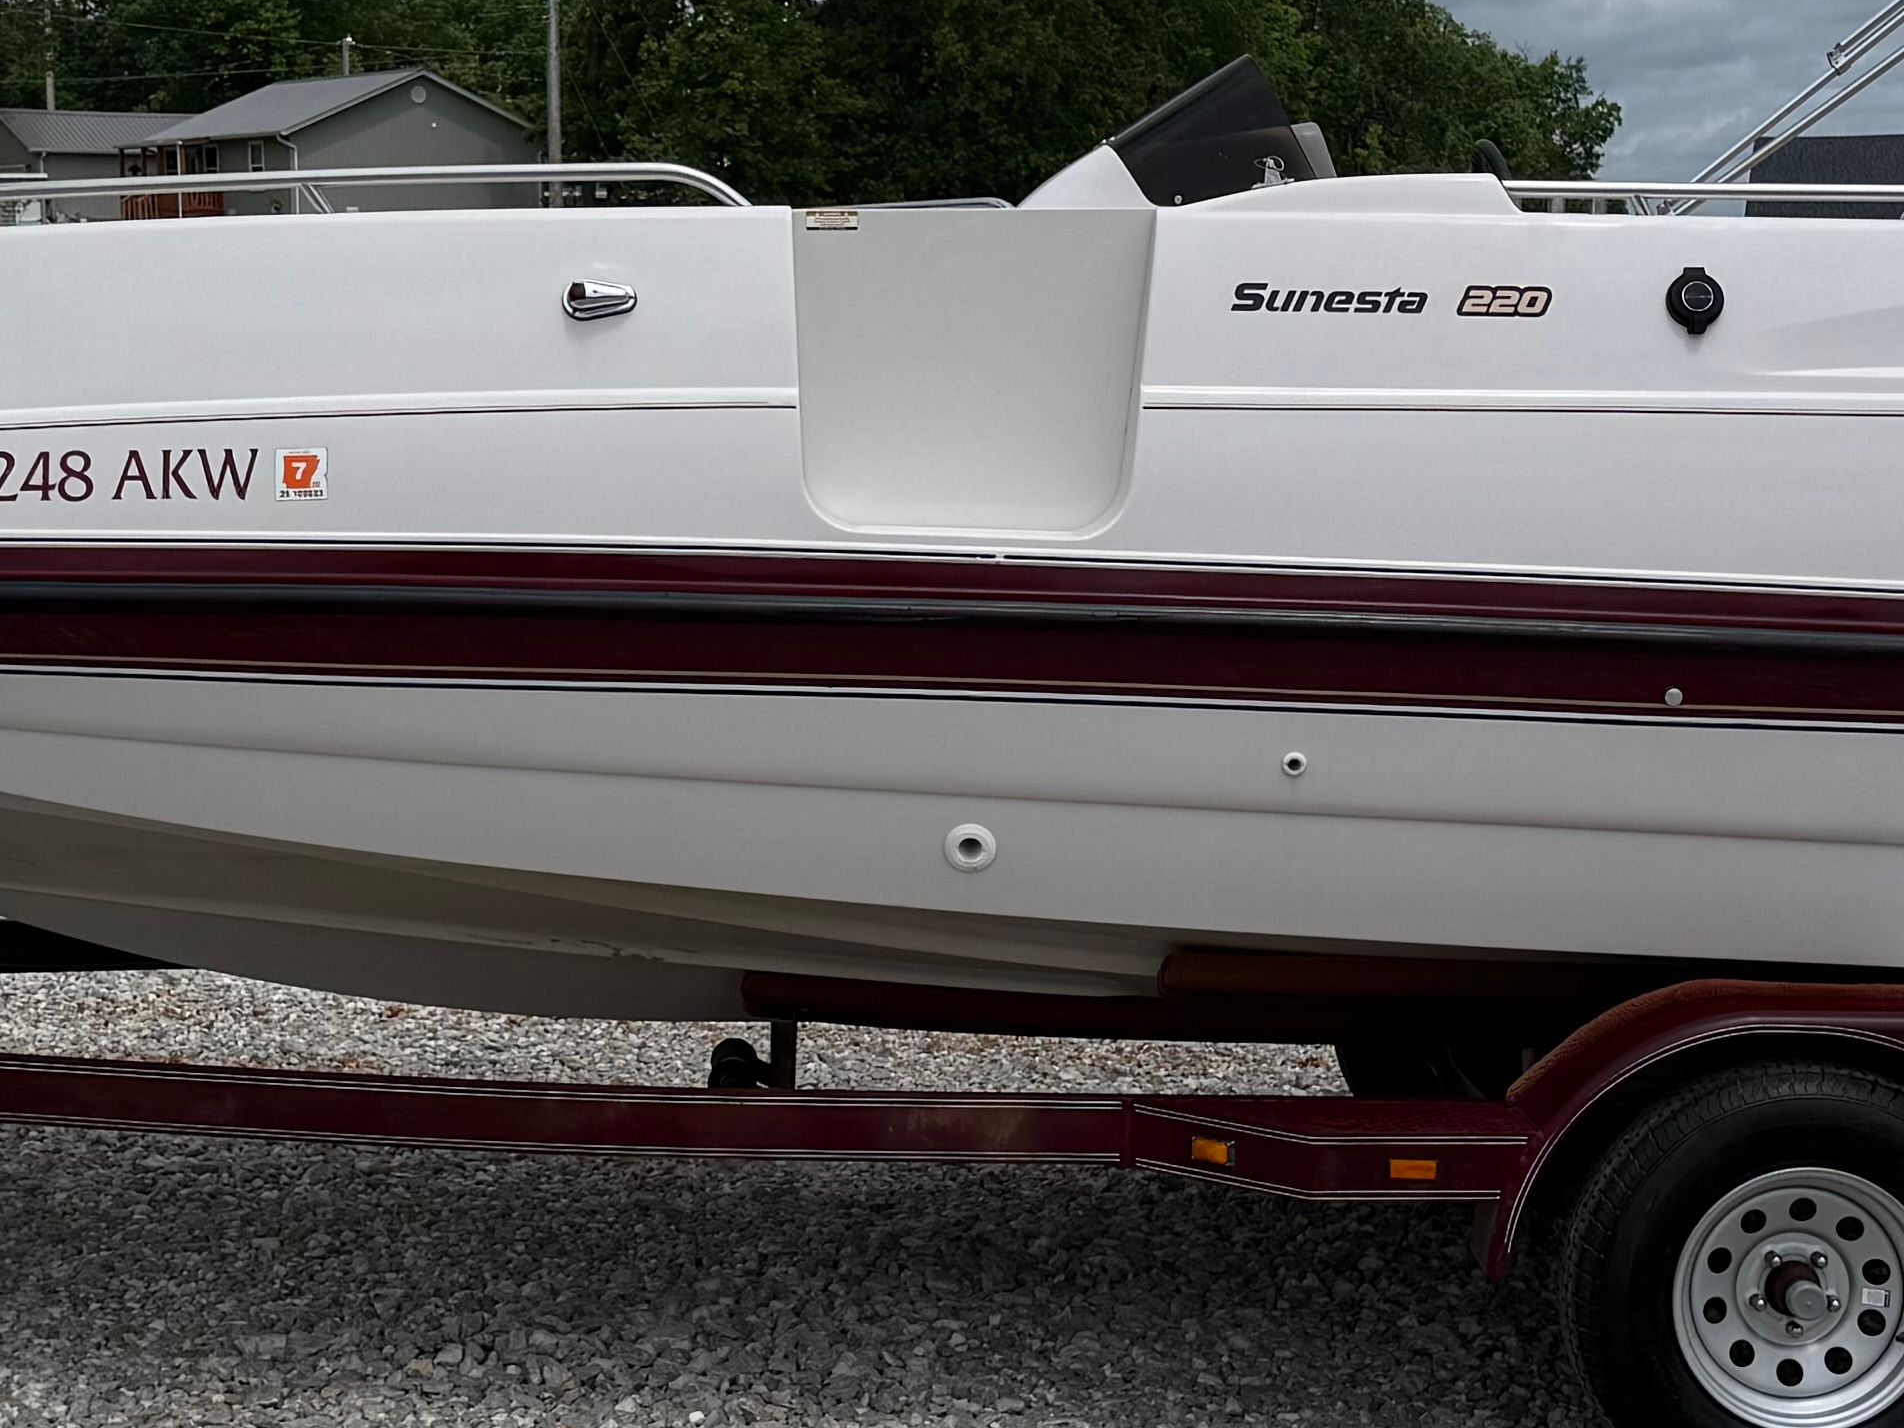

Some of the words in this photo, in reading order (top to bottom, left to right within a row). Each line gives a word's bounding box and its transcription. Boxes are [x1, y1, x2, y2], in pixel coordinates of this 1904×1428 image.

[1231, 282, 1429, 314] Sunesta
[1456, 285, 1553, 318] 220
[111, 447, 259, 502] AKW
[291, 461, 307, 480] 7
